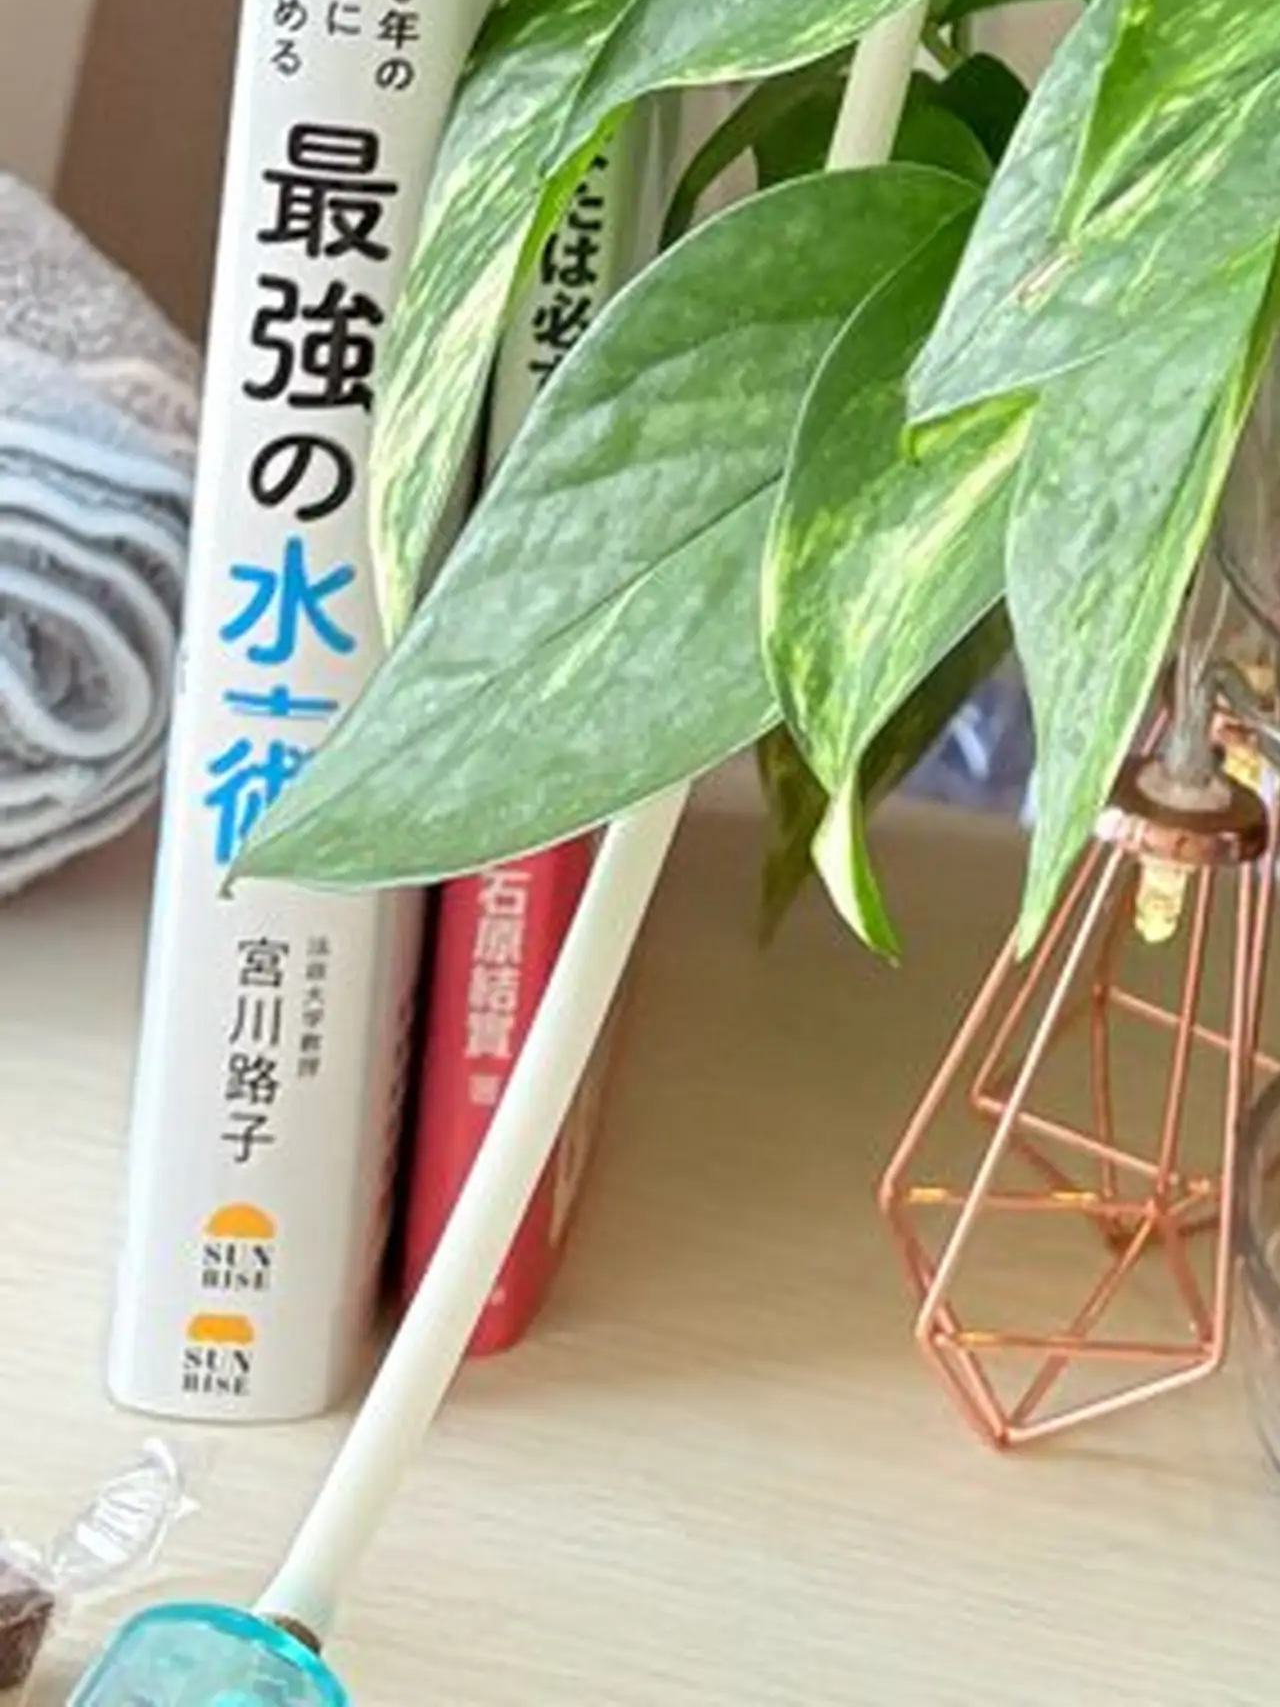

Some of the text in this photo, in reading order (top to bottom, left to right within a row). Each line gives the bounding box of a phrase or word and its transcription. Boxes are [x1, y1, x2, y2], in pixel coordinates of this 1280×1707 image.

[220, 936, 290, 1163] 宮川路子
[203, 1243, 273, 1267] SUN
[202, 1268, 270, 1291] RISE
[184, 1348, 251, 1372] SUN
[183, 1373, 250, 1396] RISE
